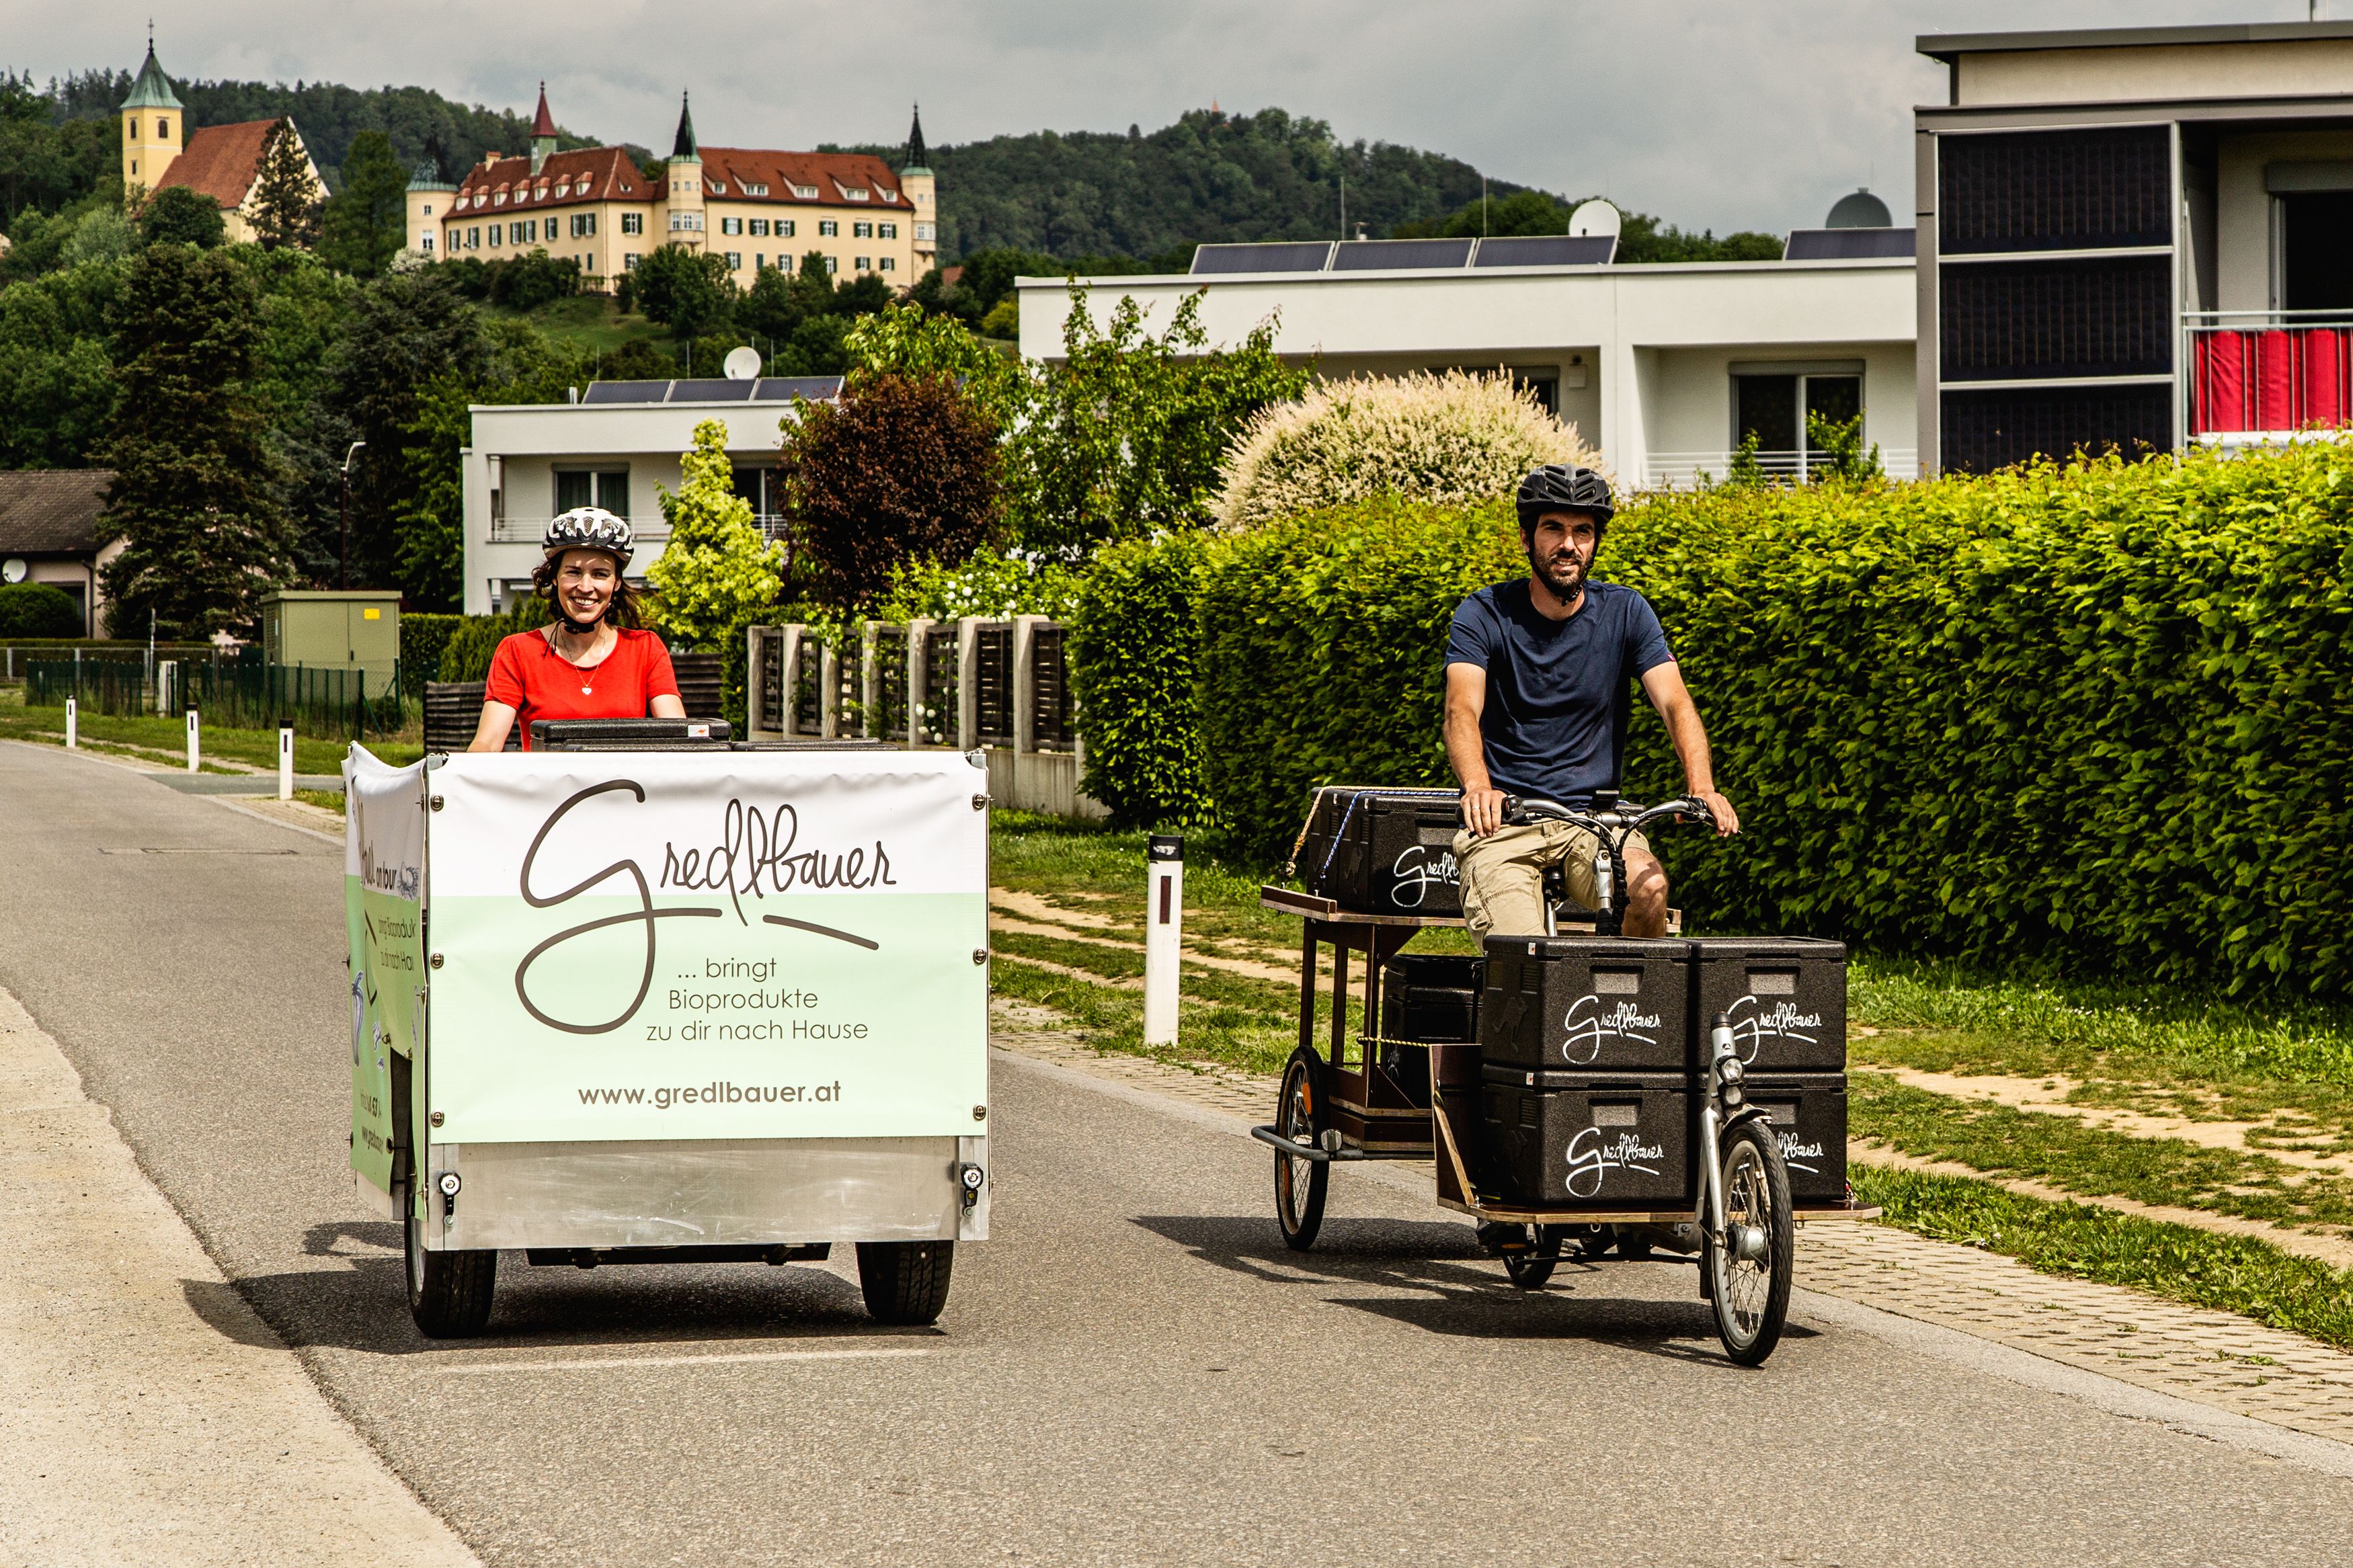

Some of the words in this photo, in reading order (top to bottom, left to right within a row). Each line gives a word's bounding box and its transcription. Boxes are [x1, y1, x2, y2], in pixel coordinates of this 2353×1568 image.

[1391, 845, 1460, 907] Gredlb
[515, 779, 897, 1035] Gredlbauer
[706, 958, 777, 983] bringt
[670, 988, 818, 1014] Bioprodukte
[646, 1025, 672, 1041] zu
[681, 1020, 711, 1040] dir
[719, 1020, 783, 1040] nach
[793, 1020, 869, 1039] Hause
[1562, 995, 1662, 1065] Gredlbauer
[578, 1080, 842, 1110] www.gredlbauer.at
[1566, 1127, 1665, 1198] Gredlbauer
